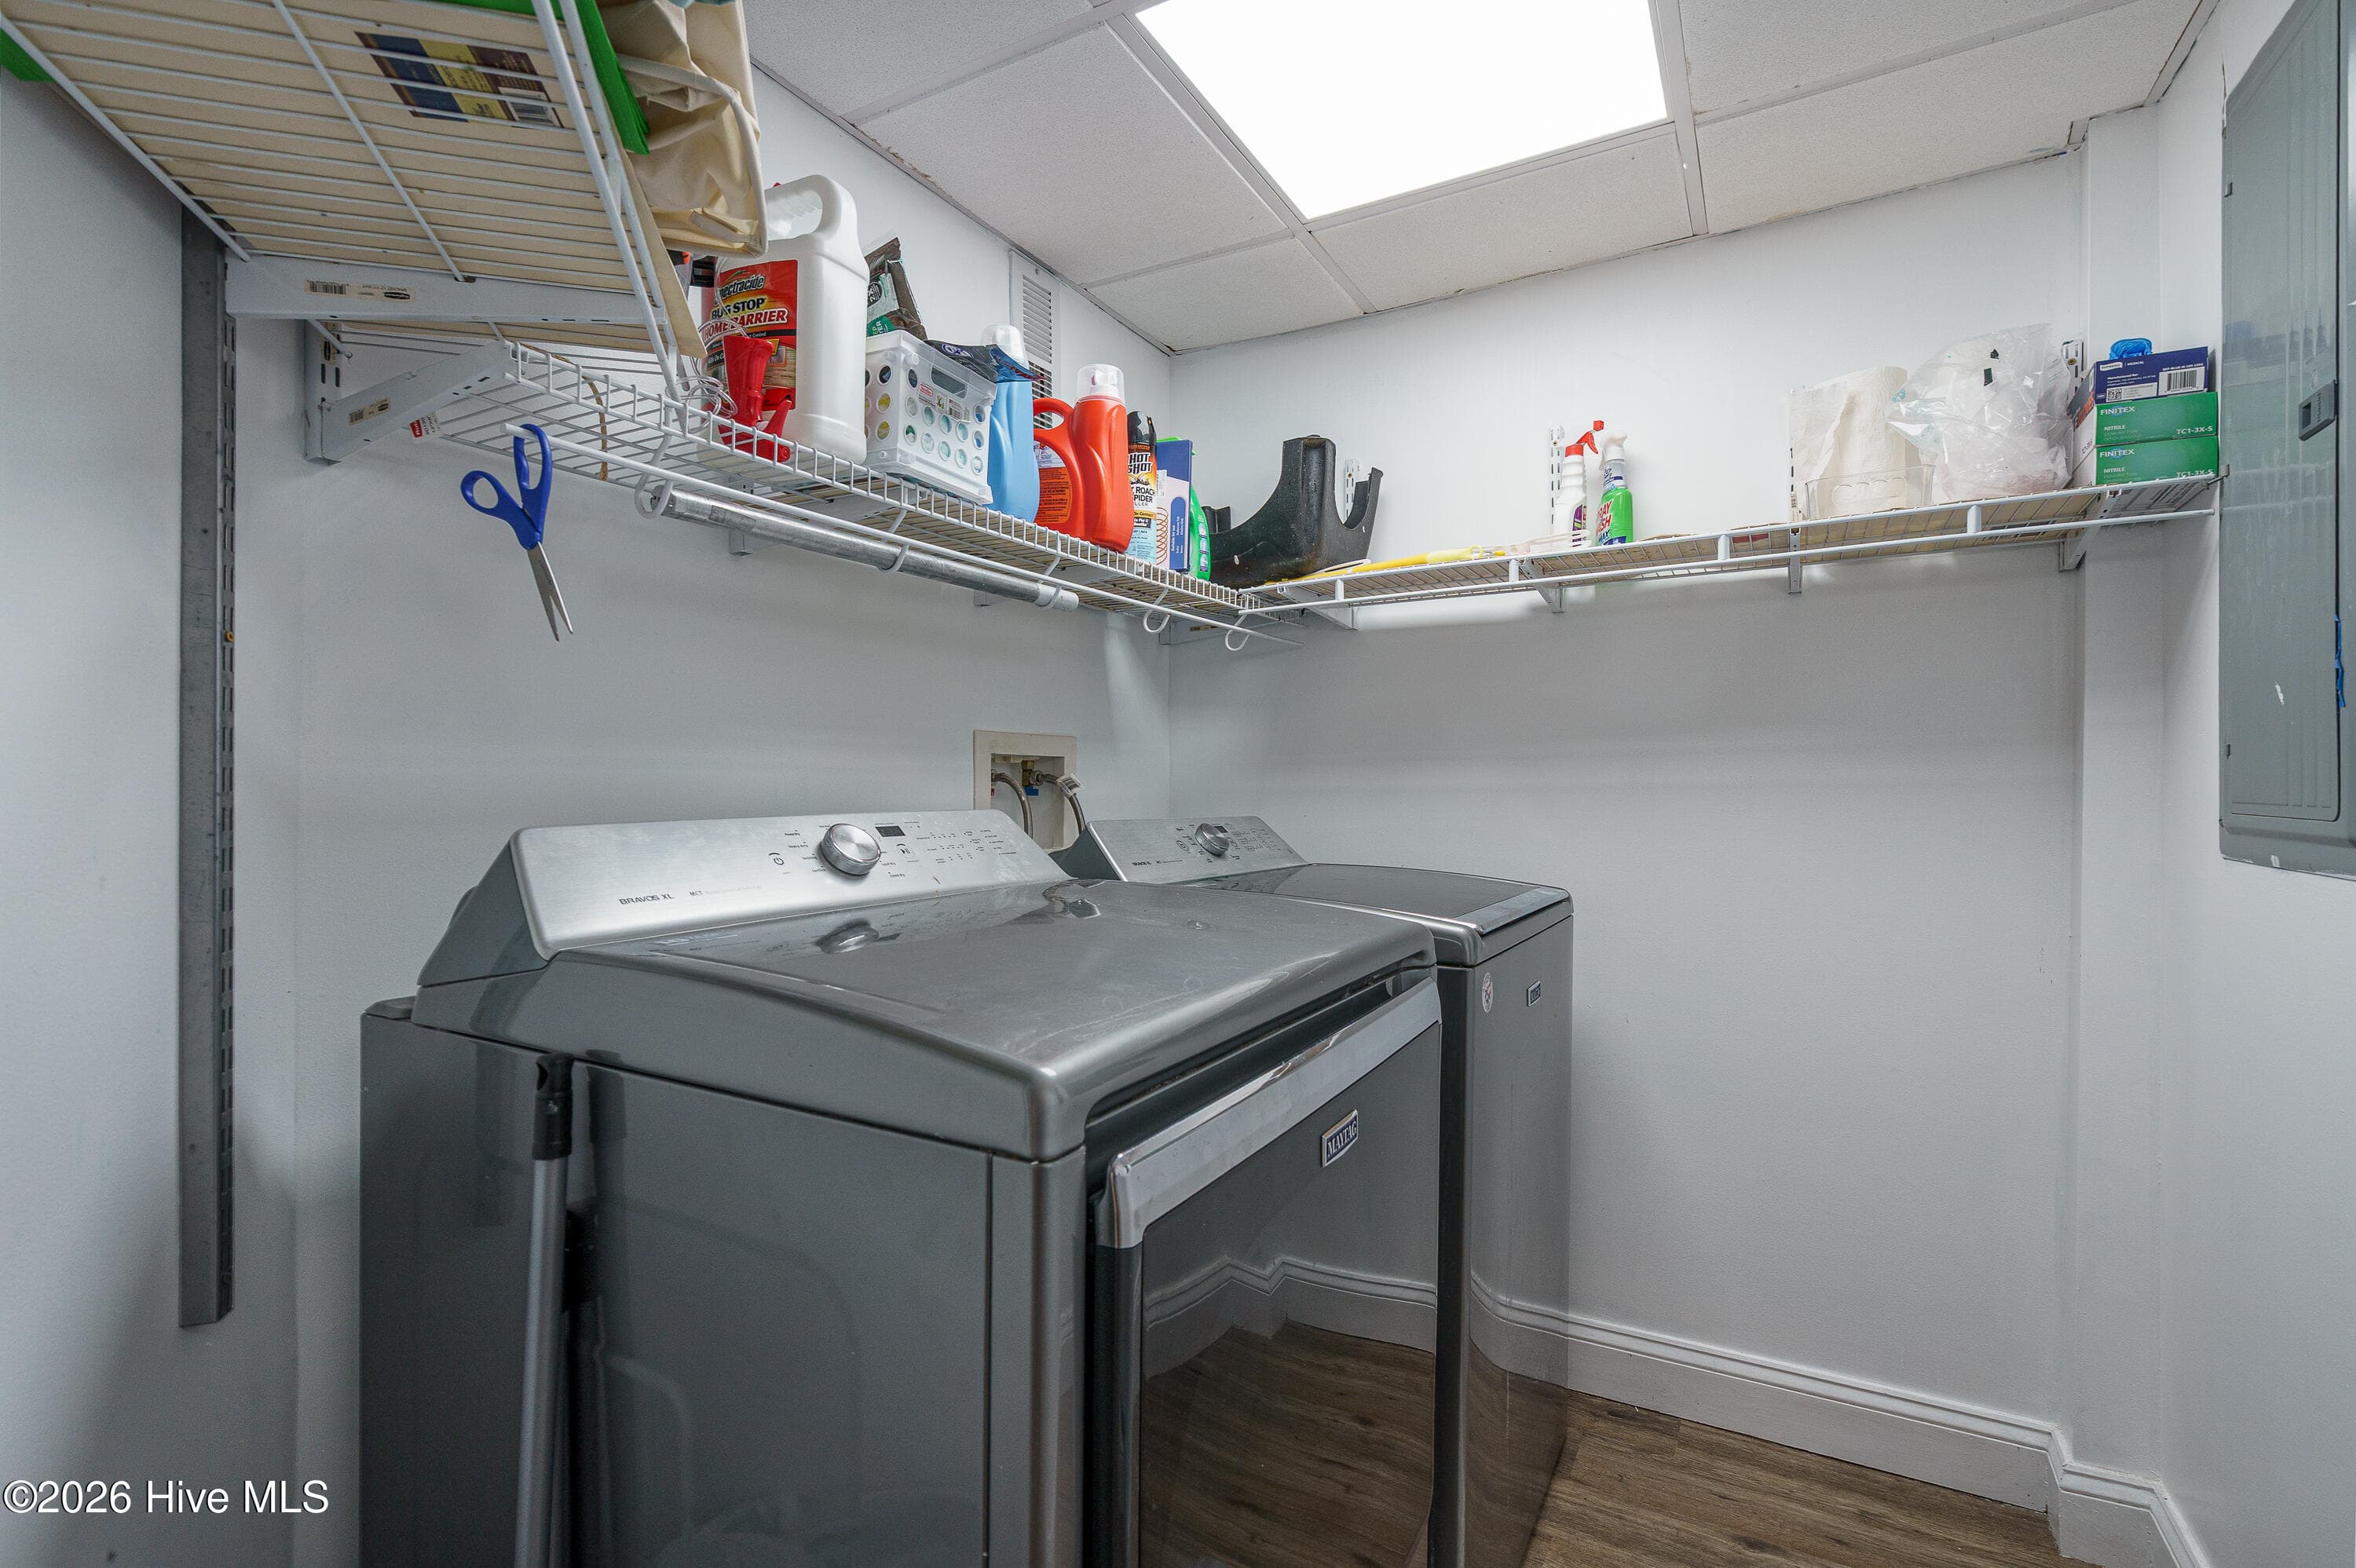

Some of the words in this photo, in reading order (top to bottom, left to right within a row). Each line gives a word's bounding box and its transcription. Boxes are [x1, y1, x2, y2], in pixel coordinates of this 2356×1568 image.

[733, 298, 763, 313] STOP
[2100, 406, 2135, 415] FINITEX
[2176, 426, 2213, 434] TC1-3X-S
[1129, 453, 1149, 463] HOT
[2100, 448, 2135, 458] FINITEX
[619, 895, 660, 905] BRAVOS
[1327, 1121, 1356, 1157] MAYTAG
